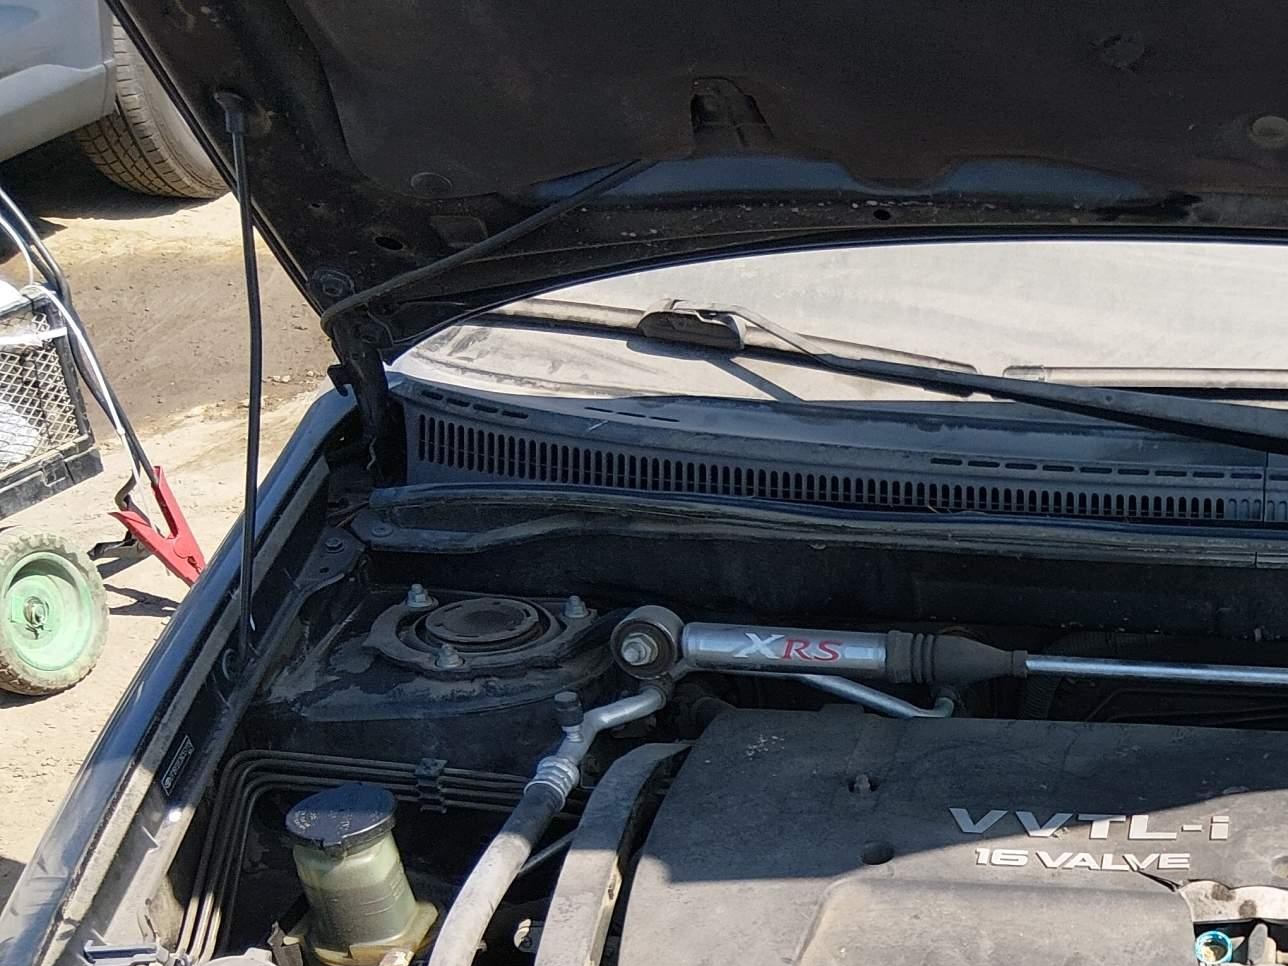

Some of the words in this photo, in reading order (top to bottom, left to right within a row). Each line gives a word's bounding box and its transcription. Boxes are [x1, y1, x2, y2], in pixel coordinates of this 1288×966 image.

[733, 632, 843, 662] XRS
[949, 807, 1230, 840] VVTL-i
[975, 848, 1029, 866] 16
[1035, 851, 1191, 872] VALVE
